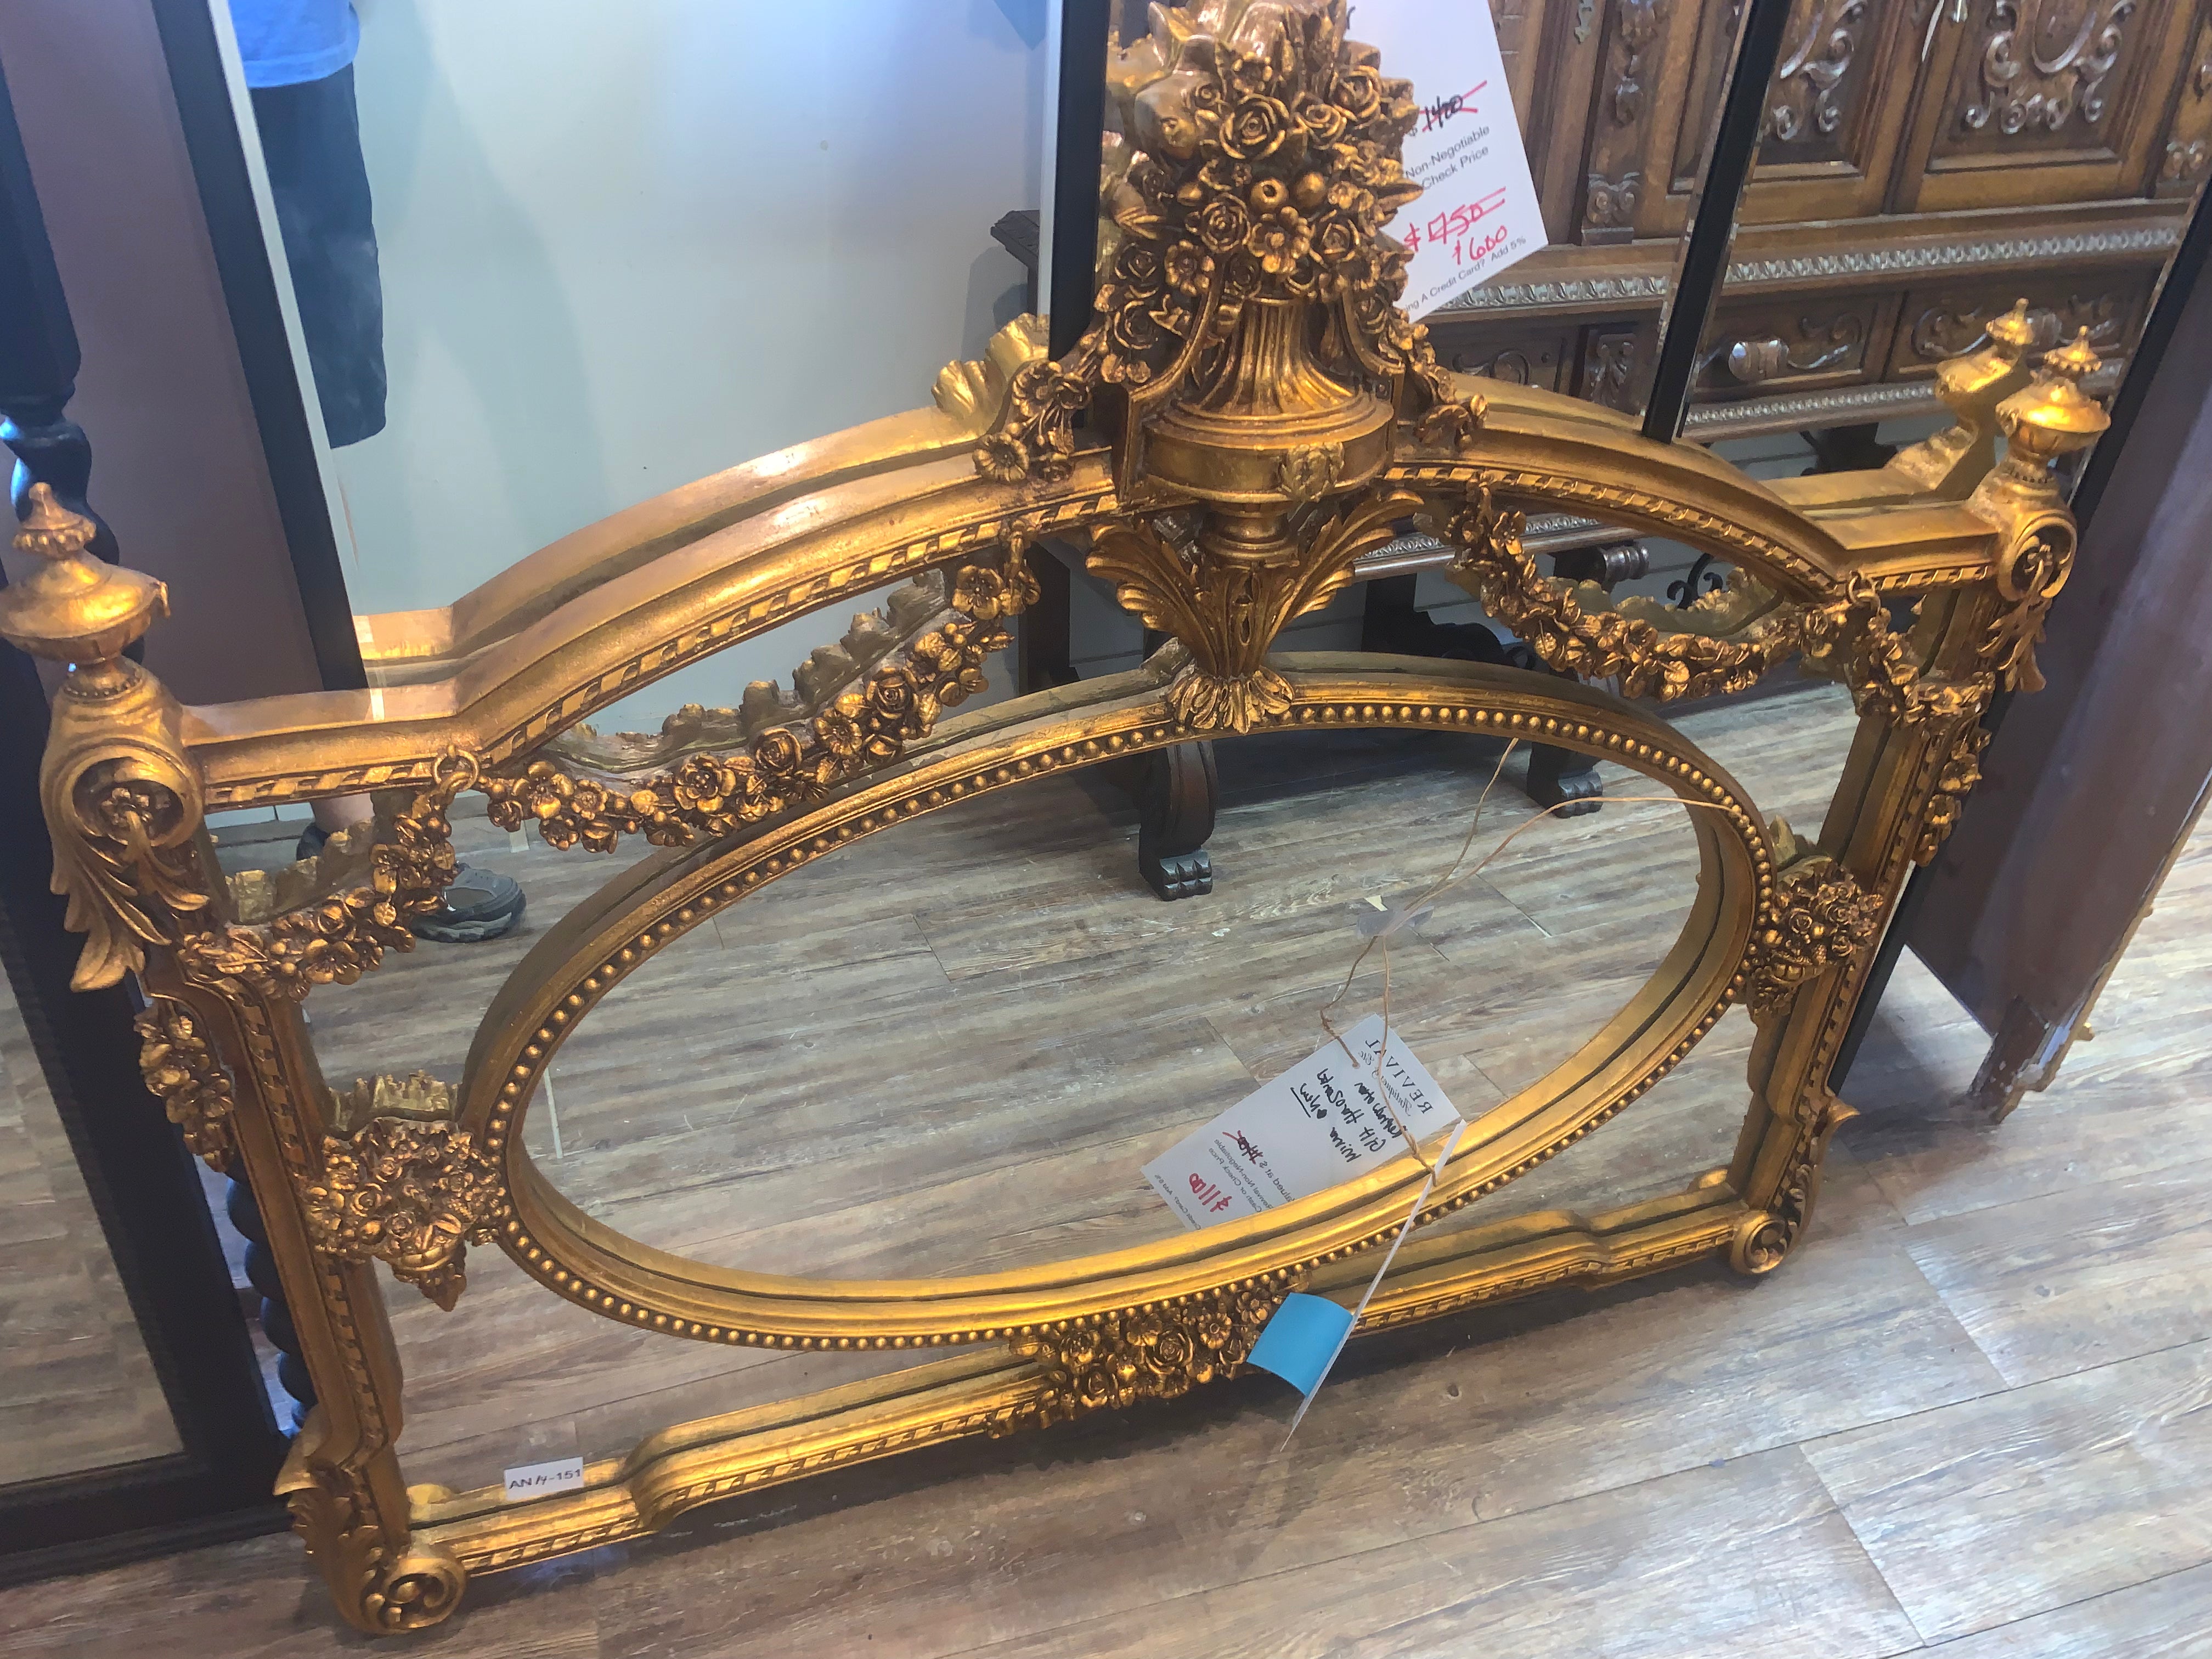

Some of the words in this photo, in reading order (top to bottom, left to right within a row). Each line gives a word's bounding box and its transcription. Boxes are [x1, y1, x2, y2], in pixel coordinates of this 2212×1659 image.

[1405, 125, 1490, 178] Non-Negotiable
[1421, 163, 1459, 190] Check
[1459, 146, 1489, 168] Price
[1421, 292, 1429, 303] A
[1429, 275, 1457, 297] Credit
[1458, 258, 1485, 280] Card?
[1491, 244, 1509, 262] Add
[1510, 235, 1527, 249] 5%
